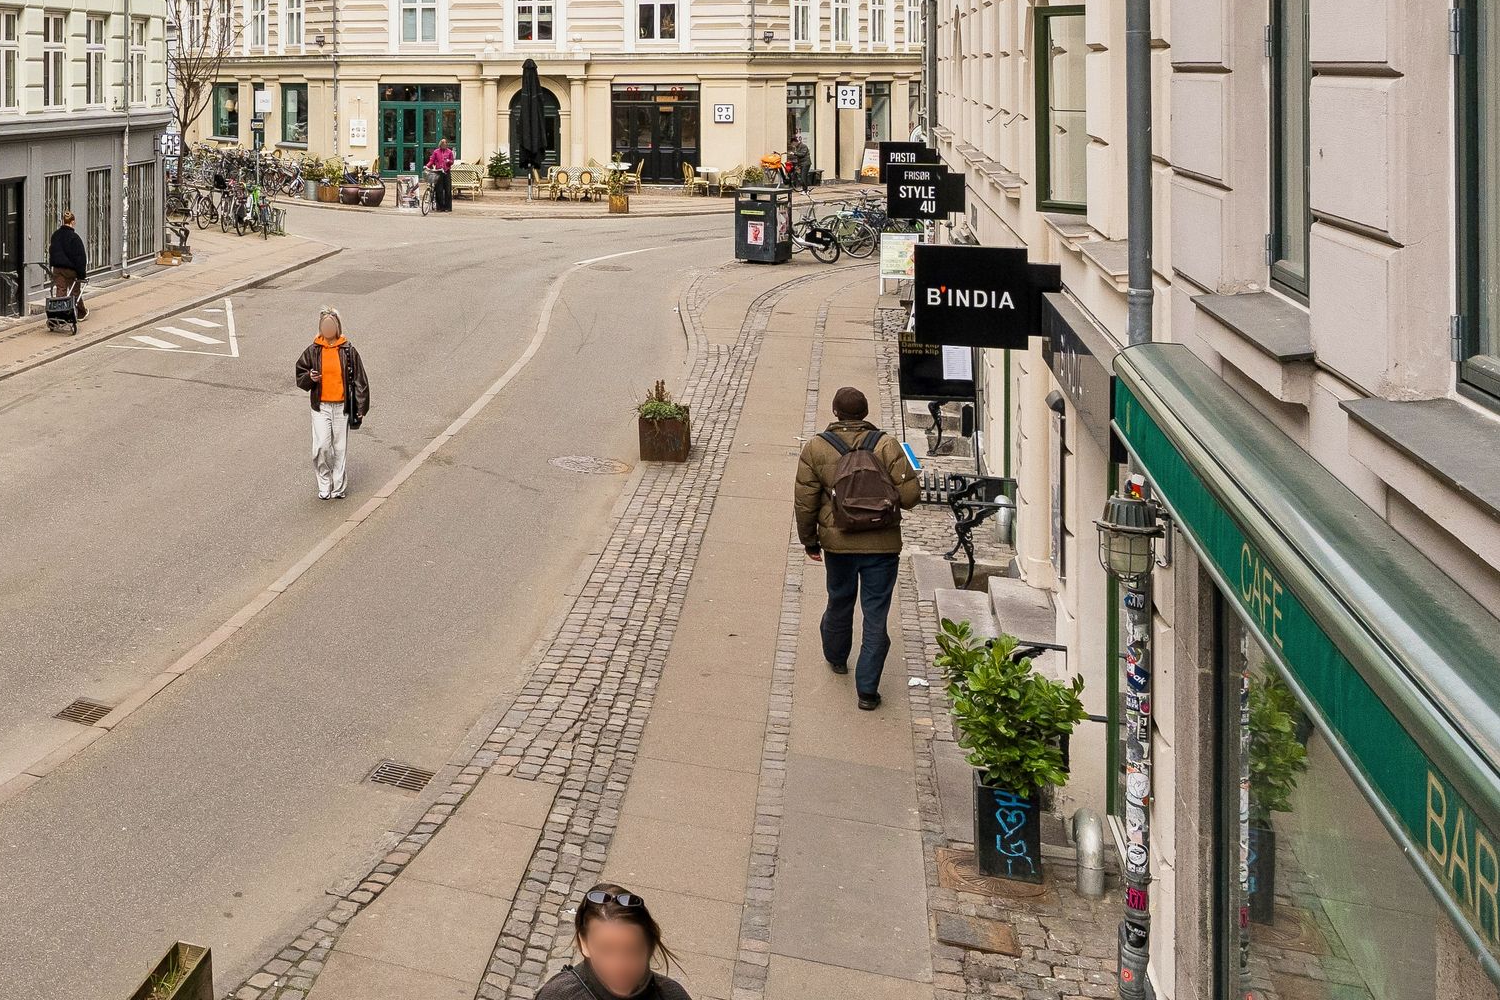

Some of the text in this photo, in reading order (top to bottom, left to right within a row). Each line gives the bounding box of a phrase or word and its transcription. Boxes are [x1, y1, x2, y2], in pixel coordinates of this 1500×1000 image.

[841, 89, 856, 97] OT
[842, 98, 856, 106] TO
[890, 152, 916, 163] PASTA
[904, 171, 930, 181] FRISØR
[899, 186, 936, 200] STYLE
[920, 201, 936, 214] 4U
[1241, 543, 1283, 648] CAFE
[1426, 770, 1500, 942] BAR
